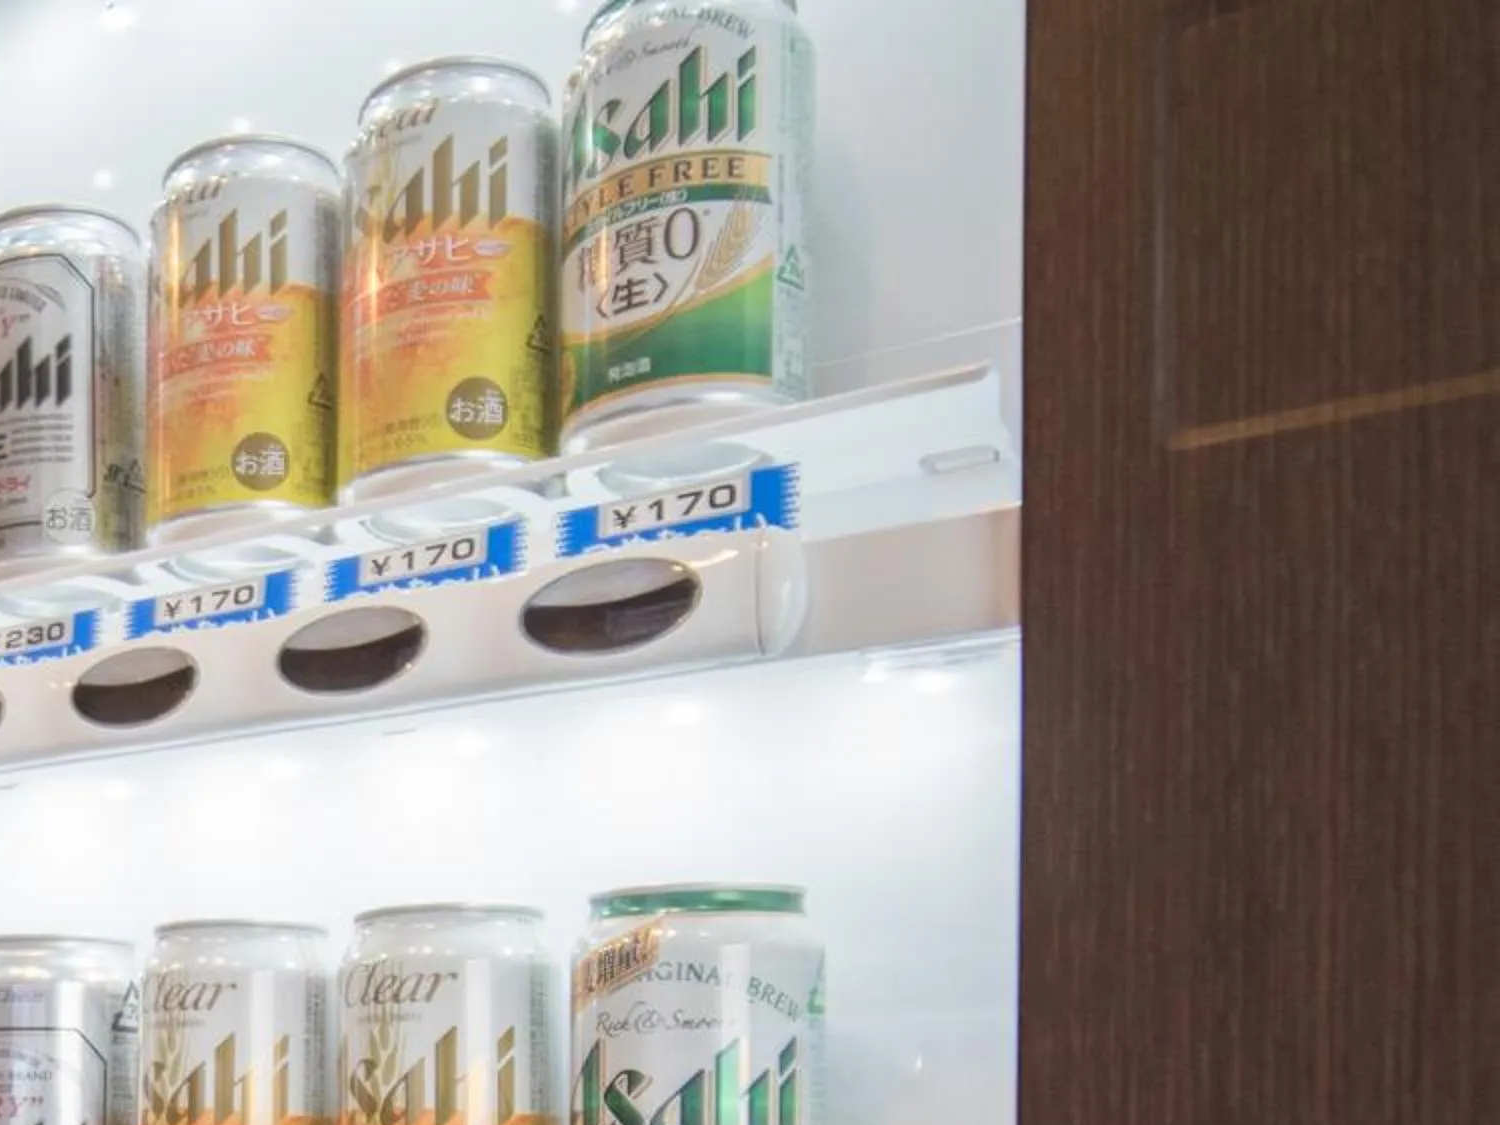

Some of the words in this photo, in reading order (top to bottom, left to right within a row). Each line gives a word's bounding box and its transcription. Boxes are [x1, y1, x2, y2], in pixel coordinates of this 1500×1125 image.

[648, 157, 746, 188] FREE
[448, 389, 504, 426] お酒
[234, 444, 287, 480] お酒
[45, 503, 94, 534] お酒
[611, 482, 738, 530] ¥170
[371, 536, 476, 578] ¥170
[163, 584, 257, 620] ¥170
